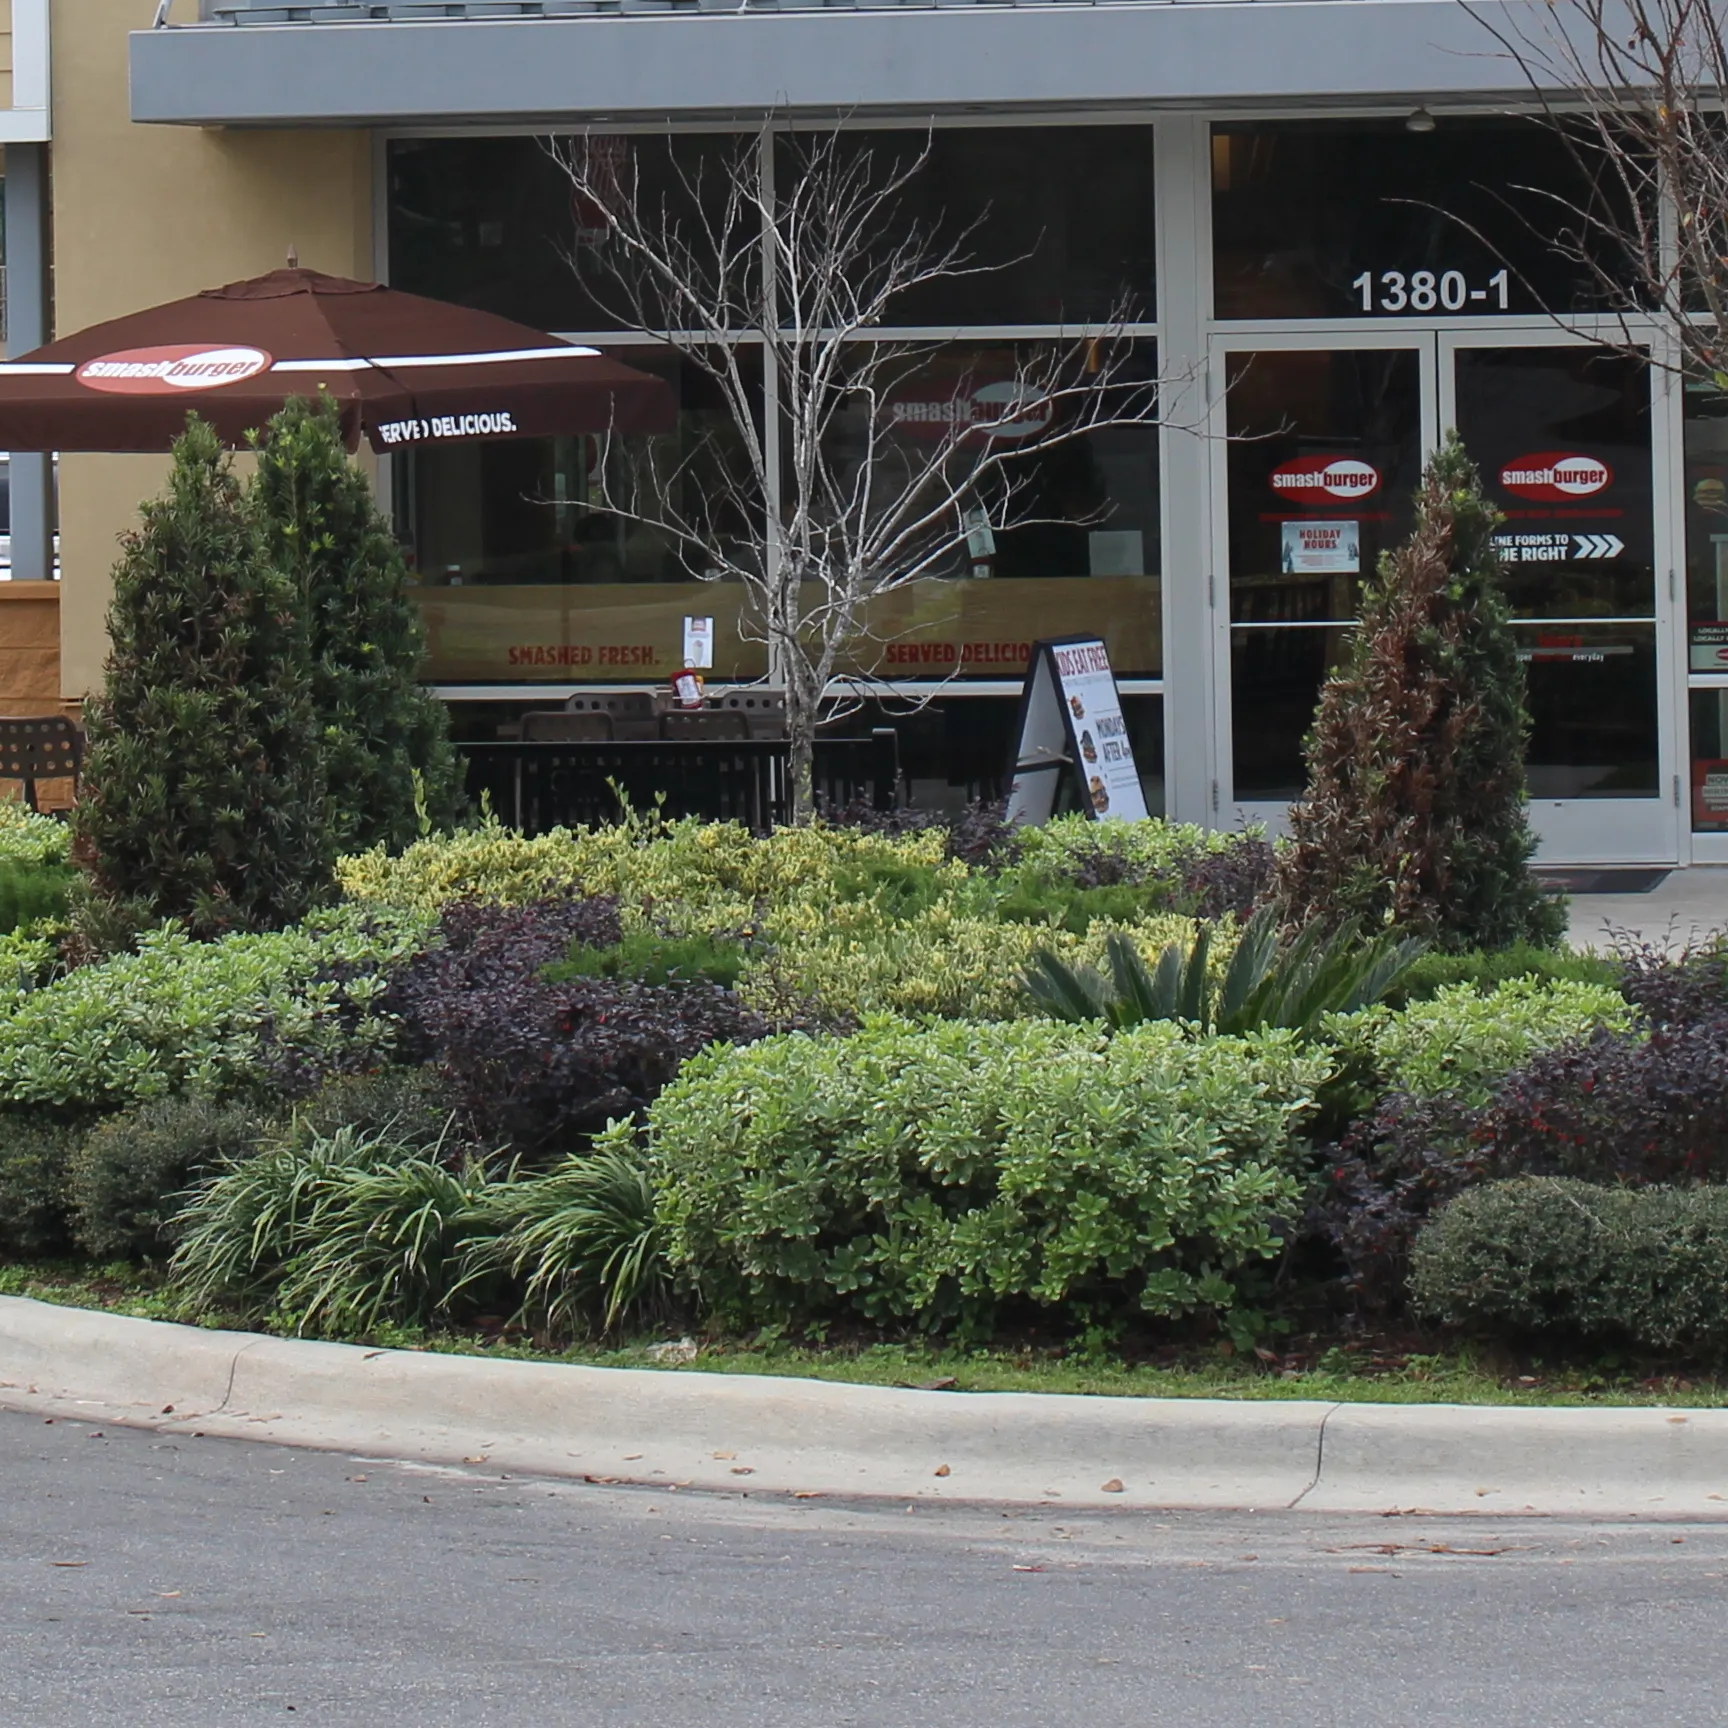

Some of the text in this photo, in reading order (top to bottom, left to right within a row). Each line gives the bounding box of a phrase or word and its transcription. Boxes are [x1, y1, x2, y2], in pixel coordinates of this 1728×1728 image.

[1353, 269, 1508, 311] 1380-1
[82, 358, 258, 379] smashburger
[378, 413, 517, 443] ERVE DELICIOUS.
[1273, 471, 1374, 488] smashburger
[1502, 468, 1605, 485] smashburger
[1299, 529, 1341, 539] HOLIDAY
[1515, 534, 1552, 546] FORMS
[1554, 533, 1569, 545] TO
[1304, 539, 1337, 549] HOURS
[1521, 546, 1568, 562] RIGHT
[508, 645, 660, 666] SMASHED FRESH.
[886, 643, 1032, 664] SERVED DELICIO
[1072, 648, 1090, 674] EAT
[1087, 646, 1109, 672] FREE
